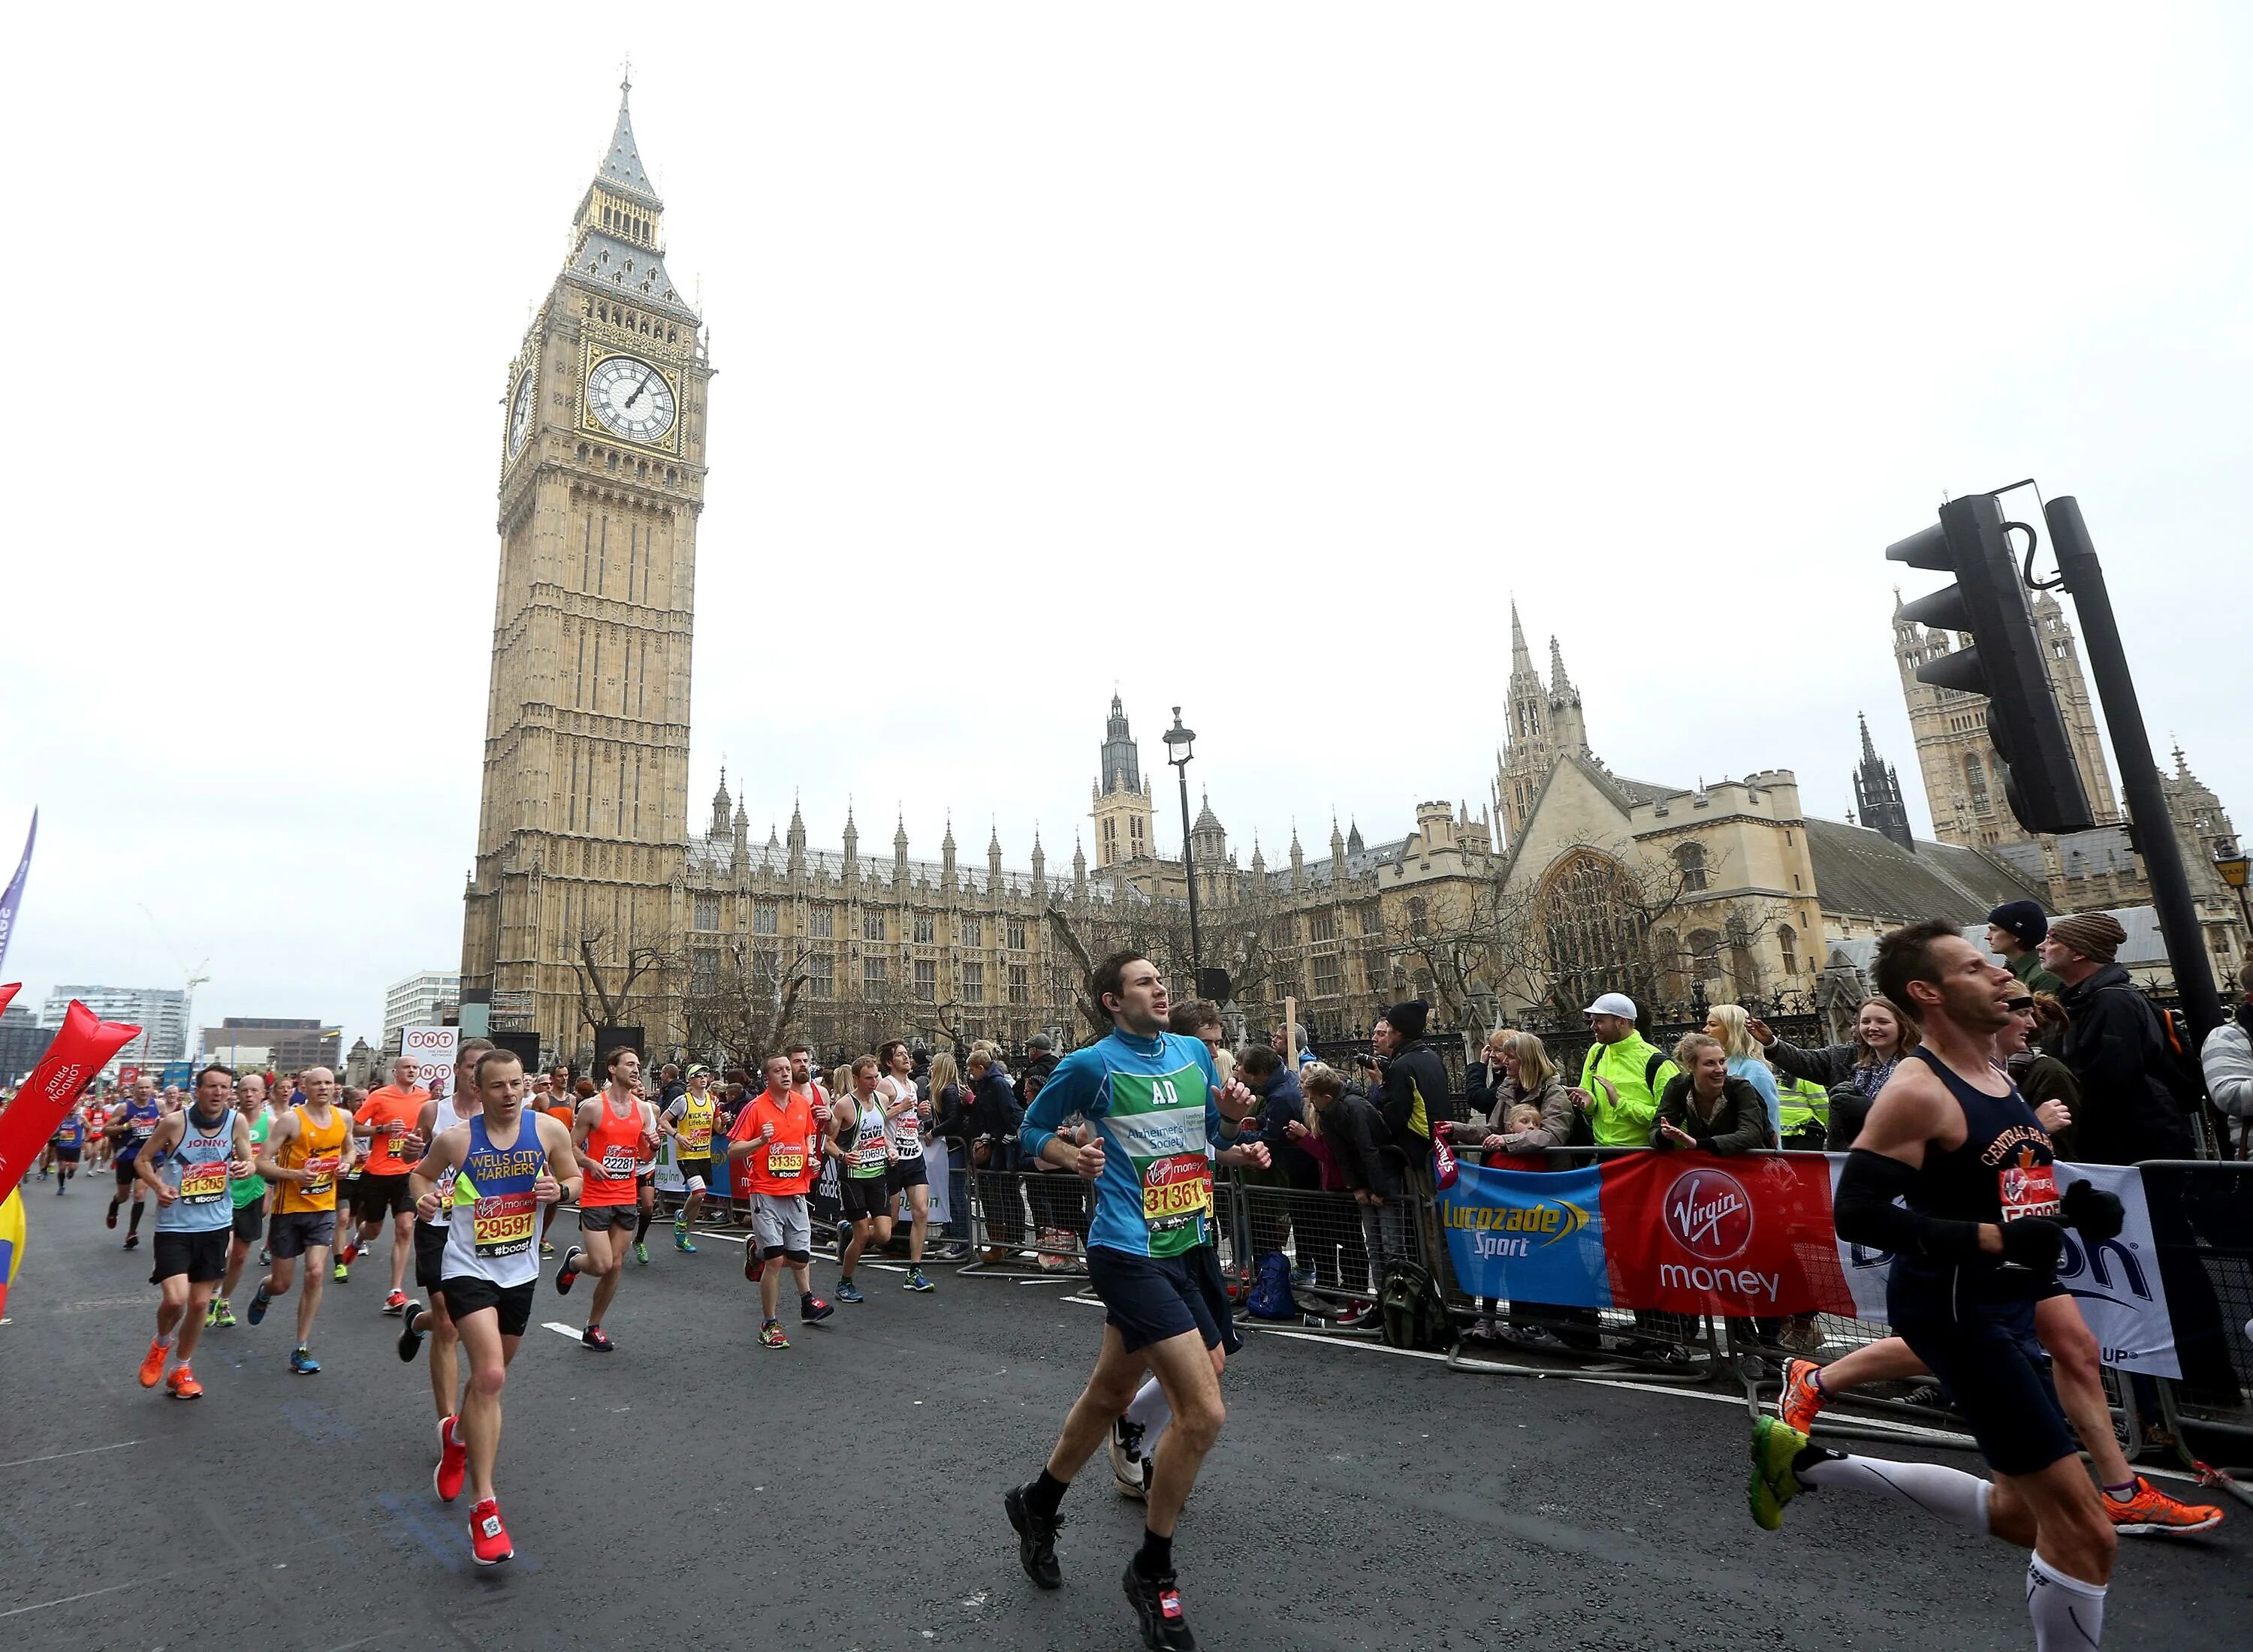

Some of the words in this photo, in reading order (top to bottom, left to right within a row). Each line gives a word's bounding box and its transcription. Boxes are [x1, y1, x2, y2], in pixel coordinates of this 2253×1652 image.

[410, 1034, 451, 1045] TNT
[44, 1066, 69, 1092] PRIDE
[48, 1064, 81, 1102] LONDON
[1152, 1081, 1178, 1105] AD
[1127, 1123, 1184, 1139] Alzheimer's
[187, 1139, 228, 1148] JONNY
[1150, 1136, 1184, 1150] Society
[1980, 1125, 2029, 1166] CENTRAL
[469, 1153, 511, 1168] WELLS
[513, 1150, 542, 1164] CITY
[604, 1157, 633, 1169] 22281
[770, 1156, 801, 1167] 31353
[860, 1148, 885, 1160] 20692
[476, 1163, 535, 1182] HARRIERS
[668, 1169, 679, 1182] Inn
[1149, 1162, 1171, 1184] Virgin
[1173, 1162, 1203, 1174] money
[182, 1177, 225, 1192] 31305
[1145, 1180, 1202, 1212] 31361
[478, 1197, 501, 1217] Virgin
[504, 1198, 535, 1209] money
[1443, 1199, 1561, 1233] Lucozade
[1673, 1179, 1743, 1246] Virgin
[476, 1215, 532, 1240] 29591
[1473, 1231, 1530, 1260] Sport
[1660, 1264, 1778, 1302] money
